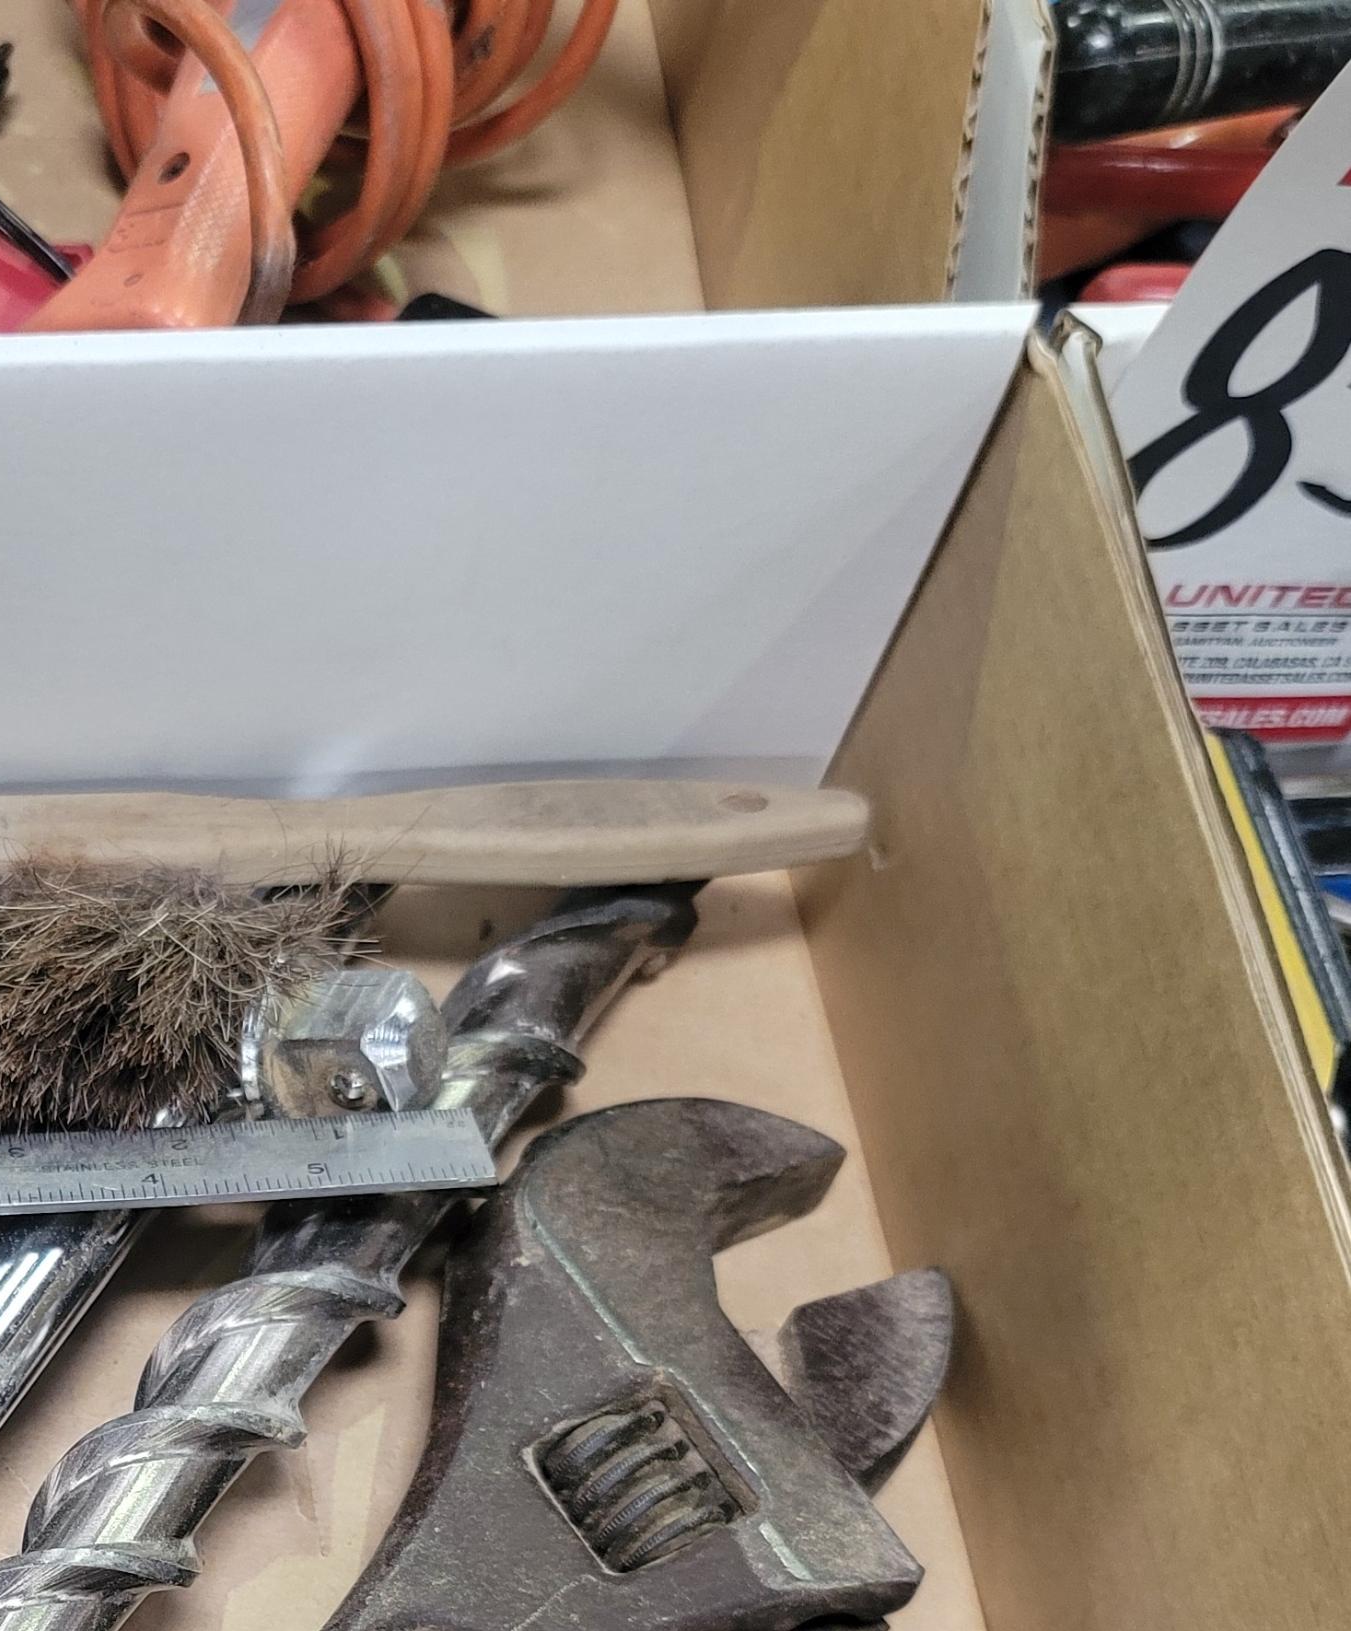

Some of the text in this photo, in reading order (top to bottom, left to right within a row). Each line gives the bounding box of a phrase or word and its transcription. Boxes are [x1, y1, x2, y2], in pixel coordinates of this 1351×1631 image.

[1126, 248, 1351, 552] 8
[1252, 621, 1349, 634] SALES
[41, 1156, 206, 1173] STAINLESS STEEL
[306, 1162, 326, 1176] 5
[141, 1172, 160, 1185] 4
